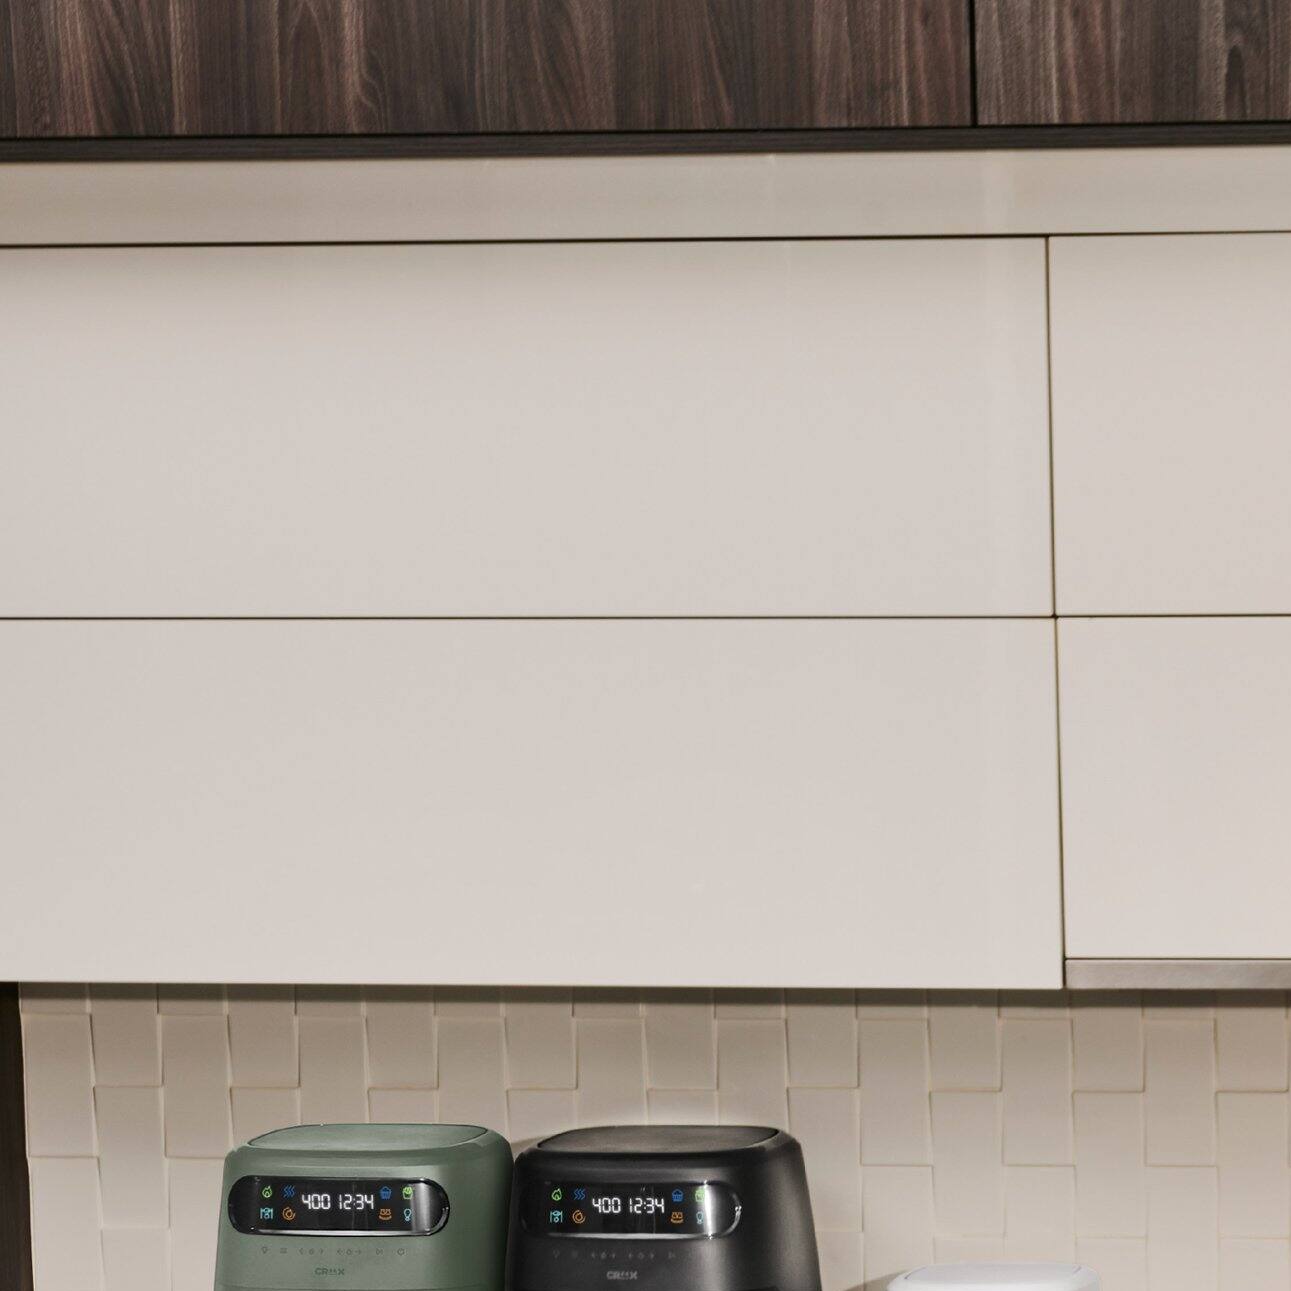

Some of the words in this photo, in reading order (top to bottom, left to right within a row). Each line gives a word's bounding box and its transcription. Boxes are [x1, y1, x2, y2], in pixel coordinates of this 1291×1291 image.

[301, 1194, 330, 1210] 400
[339, 1194, 374, 1210] 12:34
[592, 1197, 621, 1214] 400
[629, 1197, 665, 1214] 12:34
